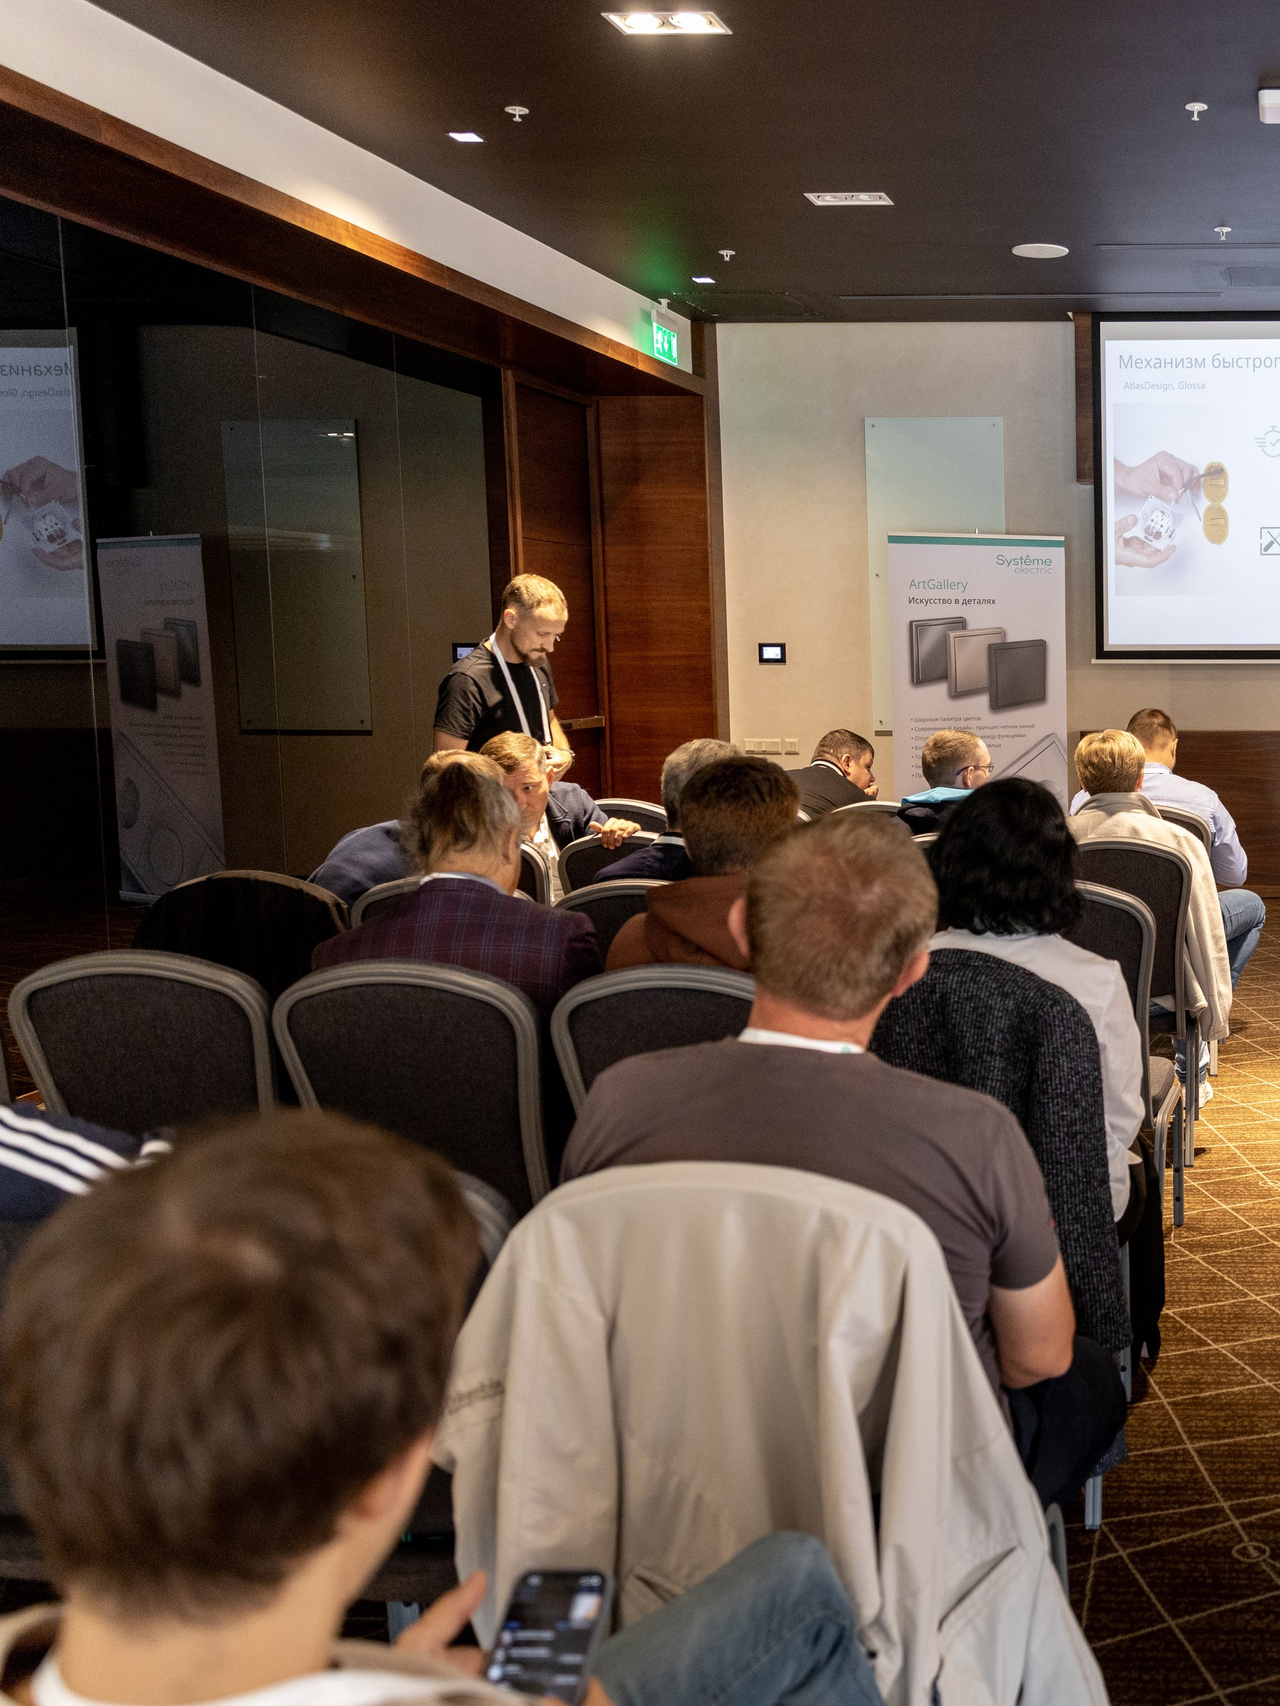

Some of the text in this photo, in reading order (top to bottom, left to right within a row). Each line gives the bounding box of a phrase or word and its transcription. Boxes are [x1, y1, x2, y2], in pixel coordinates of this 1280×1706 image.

[1119, 354, 1206, 370] Механизм
[1123, 380, 1206, 393] AtlasDesign, Glossa
[996, 554, 1053, 568] Systême
[1014, 567, 1053, 575] electric
[908, 578, 969, 594] ArtGallery
[908, 596, 952, 607] Искусство
[961, 597, 996, 607] деталях
